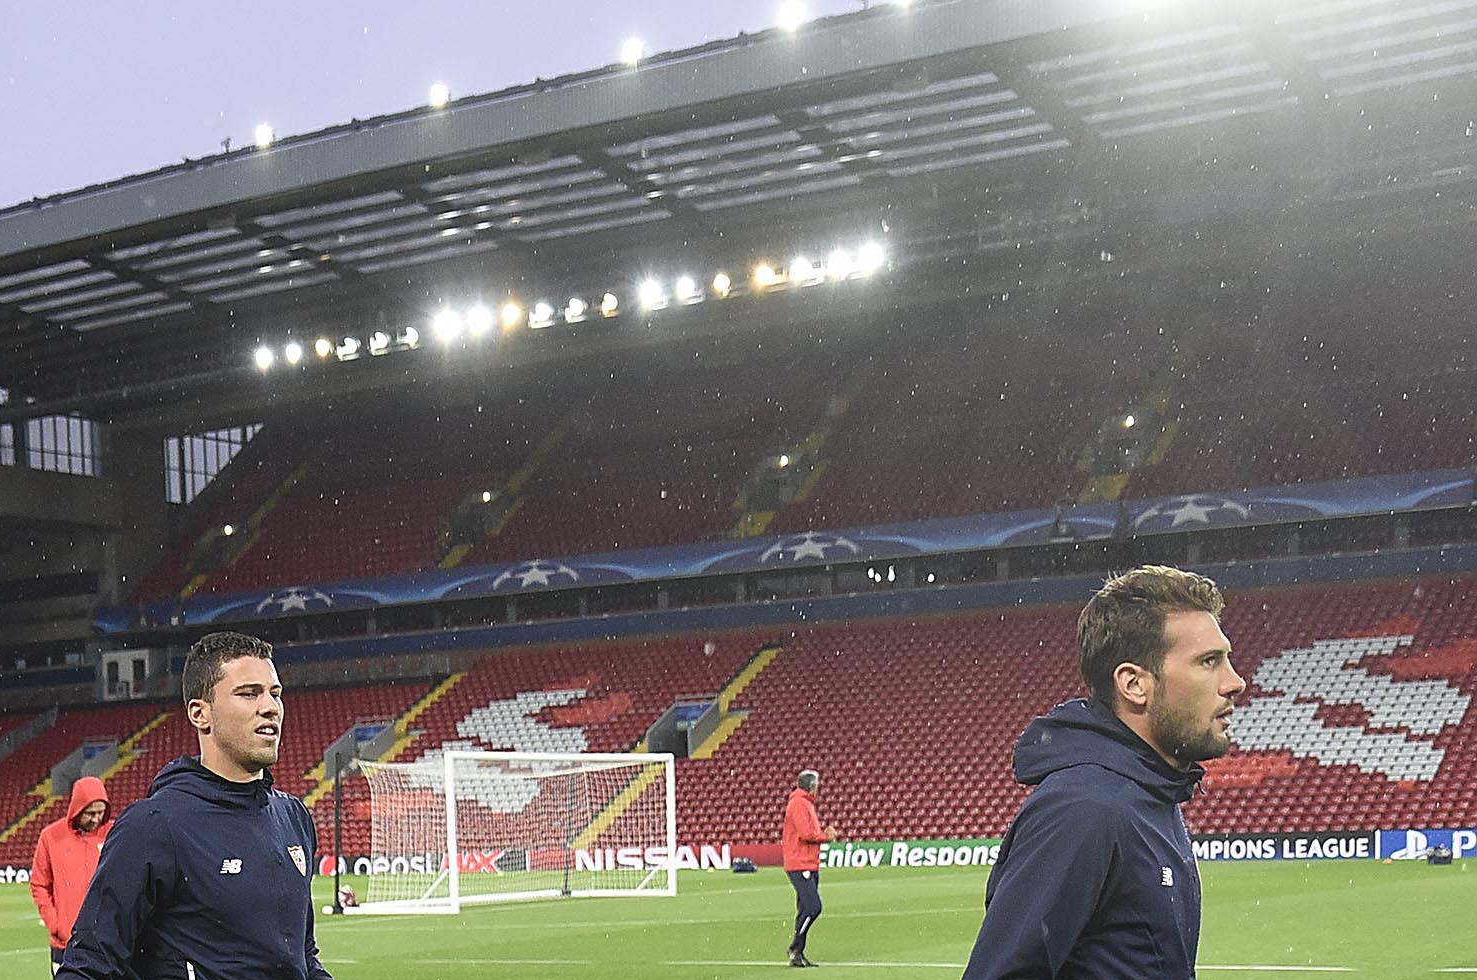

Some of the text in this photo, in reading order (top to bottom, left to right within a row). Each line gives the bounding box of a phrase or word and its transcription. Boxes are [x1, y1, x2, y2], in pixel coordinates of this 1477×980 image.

[575, 844, 731, 871] NISSAN
[1282, 838, 1369, 859] LEAGUE
[354, 852, 432, 875] pepsi
